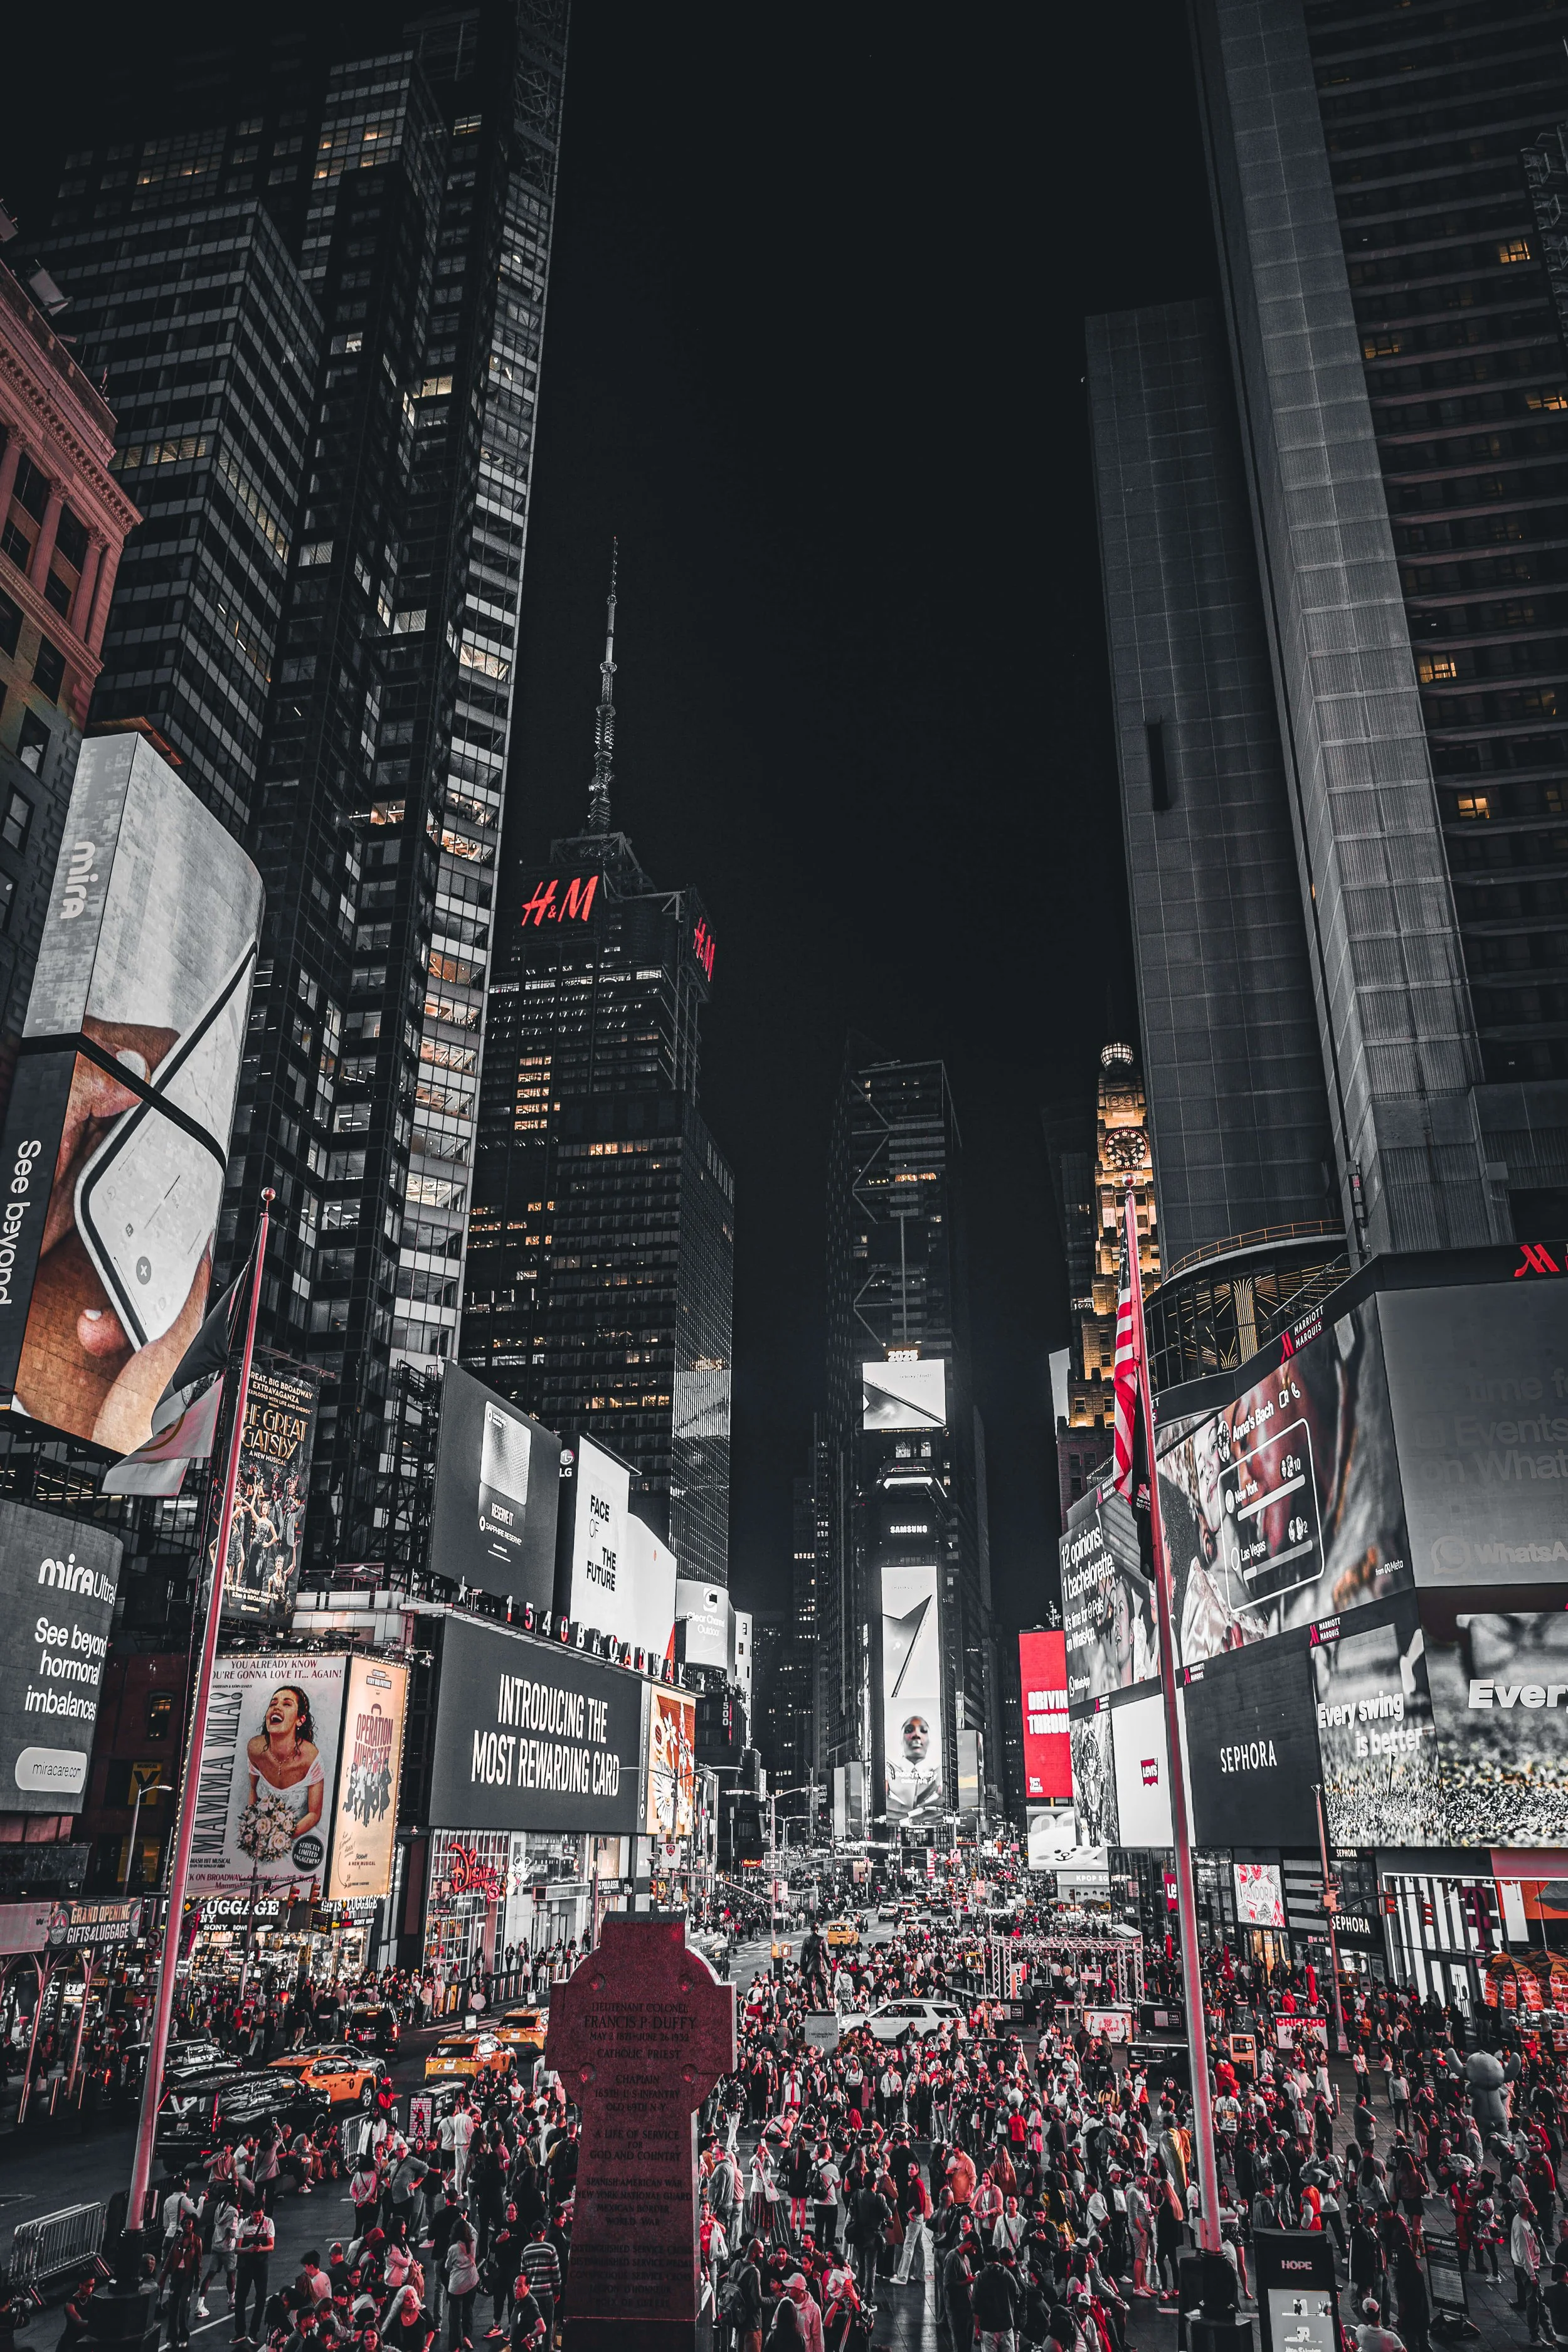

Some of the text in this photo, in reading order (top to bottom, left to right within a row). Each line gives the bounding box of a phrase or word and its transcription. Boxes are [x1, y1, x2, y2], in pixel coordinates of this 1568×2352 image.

[60, 841, 98, 919] mira
[522, 876, 598, 927] H&M
[693, 917, 716, 982] H&M
[0, 1140, 41, 1305] See beyond
[1294, 1305, 1323, 1336] MARRIOTT
[1296, 1321, 1322, 1348] MARQUIS
[252, 1382, 299, 1404] EXTRAVAGANZA
[268, 1377, 313, 1399] BIG BROADWAY
[263, 1409, 308, 1441] GREAT
[1233, 1400, 1274, 1442] Anna's Bach
[242, 1426, 298, 1459] GATSBY
[253, 1451, 286, 1466] NEW MUSICAL
[1293, 1458, 1301, 1471] 10
[559, 1468, 572, 1478] LG
[1234, 1480, 1259, 1504] New York
[491, 1502, 509, 1524] RESERVE
[590, 1494, 610, 1522] FACE
[485, 1522, 504, 1537] SAPPHIRE
[590, 1518, 599, 1539] OF
[890, 1525, 928, 1534] SAMSUNG
[1303, 1521, 1308, 1534] 2
[1061, 1527, 1103, 1570] 12 opinions.
[1240, 1540, 1266, 1561] Las Vegas
[602, 1547, 617, 1571] THE
[1390, 1559, 1404, 1571] Meta
[586, 1560, 616, 1591] FUTURE
[1062, 1551, 1115, 1601] 1 bachelorette.
[236, 1586, 260, 1595] BROADWAY
[247, 1594, 271, 1604] BROADWAY
[687, 1611, 725, 1628] Clear Channel
[1072, 1611, 1081, 1628] time
[1092, 1597, 1104, 1617] Polls
[697, 1624, 719, 1636] Outdoor
[1318, 1617, 1340, 1631] MARRIOTT
[34, 1617, 108, 1658] See beyond
[1066, 1626, 1096, 1653] on WhatsApp.
[1320, 1628, 1339, 1640] MARQUIS
[571, 1621, 686, 1688] BROADWAY
[40, 1650, 100, 1686] hormonal
[231, 1660, 318, 1669] YOU ALREADY KNOW
[238, 1670, 342, 1679] GONNA LOVE IT... AGAIN!
[1074, 1676, 1090, 1690] WhatsApp
[24, 1685, 96, 1721] imbalances
[498, 1673, 608, 1744] INTRODUCING THE
[1317, 1690, 1404, 1729] Every swing
[356, 1714, 393, 1747] OPERATION
[1355, 1725, 1423, 1757] is better
[471, 1729, 620, 1797] MOST REWARDING CARD
[1221, 1740, 1277, 1773] SEPHORA
[33, 1762, 81, 1777] miracare.com
[192, 1692, 243, 1855] MAMMA MIA!
[299, 1842, 321, 1852] STRICTLY
[299, 1849, 319, 1858] LIMITED
[1336, 1849, 1357, 1858] SEPHORA
[294, 1854, 320, 1864] ENGAGEMENT
[1242, 1885, 1274, 1902] PANDORA
[347, 1897, 377, 1910] LUGGAGE
[71, 1904, 131, 1924] GRAND OPENING
[200, 1914, 216, 1923] NY
[1332, 1915, 1370, 1934] SEPHORA
[592, 2003, 689, 2013] LIEUTENANT COLONEL
[584, 2015, 697, 2030] FRANCIS DUFFY
[590, 2032, 689, 2042] MAY 26 1932
[597, 2048, 681, 2059] CATHOLIC PRIEST
[615, 2075, 659, 2084] CHAPLAIN
[596, 2089, 680, 2099] 165TH INFANTRY
[606, 2103, 624, 2112] OLD
[605, 2130, 679, 2140] LIFE OF SERVICE
[590, 2150, 681, 2161] GOD AND COUNTRY
[664, 2179, 682, 2188] WAR
[576, 2190, 692, 2201] NEW YORK NATIONAL GUARD
[596, 2204, 669, 2214] MEXICAN BORDER
[605, 2217, 660, 2226] WORLD WAR
[571, 2244, 630, 2253] DISTINGUISHED
[633, 2245, 662, 2254] SERVICE
[632, 2258, 663, 2267] SERVICE
[1281, 2260, 1312, 2270] HOPE
[632, 2271, 663, 2280] SERVICE
